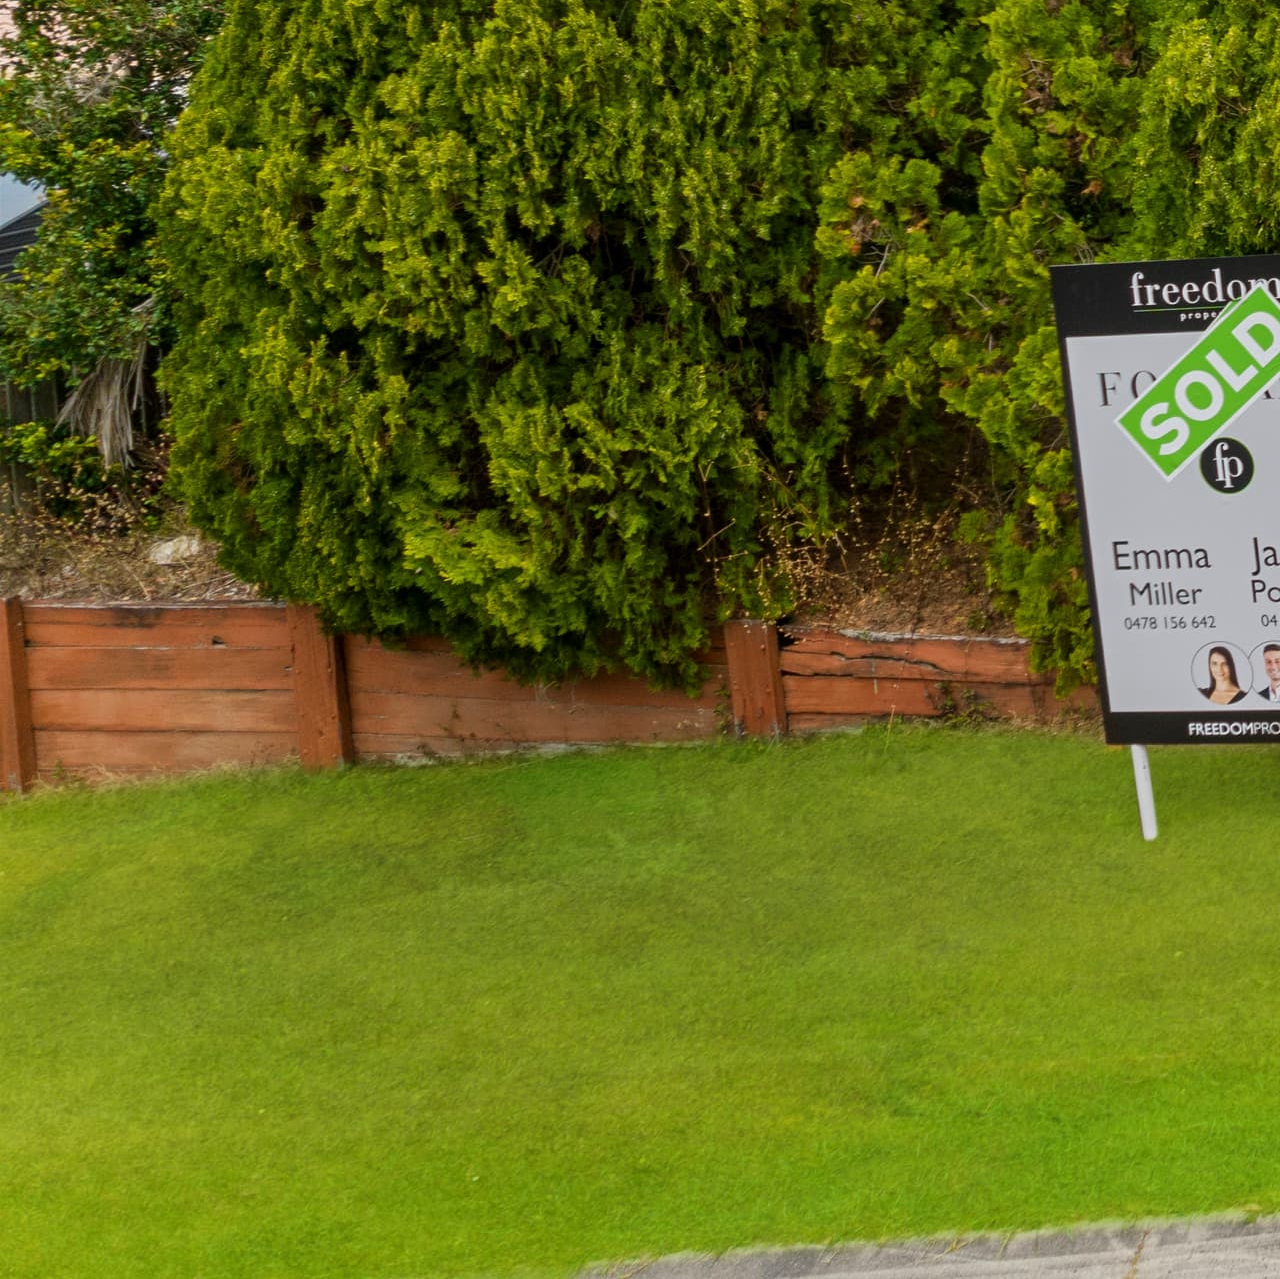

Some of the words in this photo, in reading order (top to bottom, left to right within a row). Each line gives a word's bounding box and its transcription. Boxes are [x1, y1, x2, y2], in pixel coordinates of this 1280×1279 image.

[1179, 311, 1219, 322] prope
[1112, 541, 1212, 570] Emma
[1129, 581, 1203, 606] Miller
[1124, 616, 1158, 630] 0478
[1163, 616, 1187, 630] 156
[1191, 615, 1217, 629] 642
